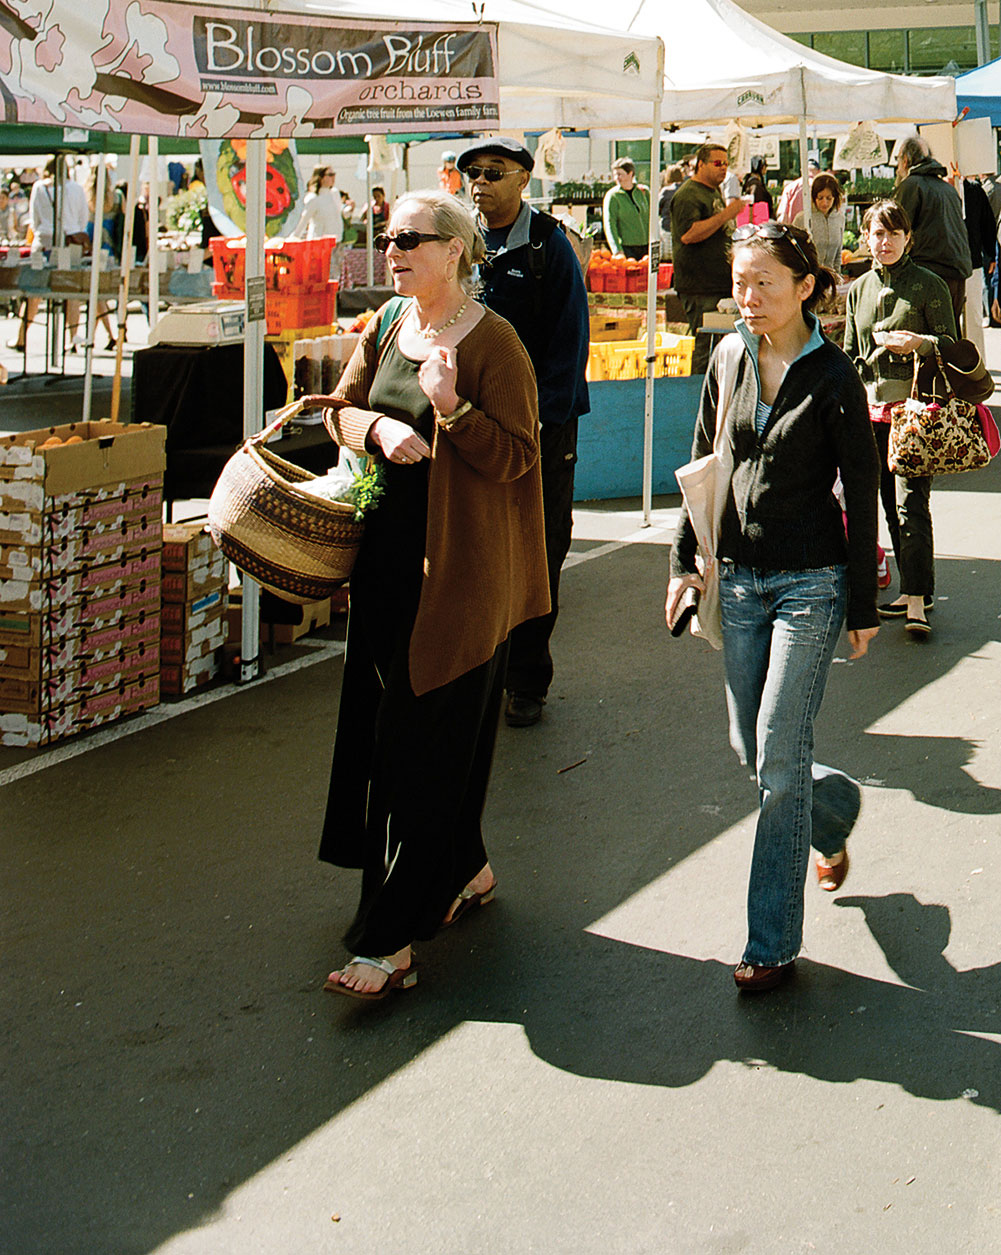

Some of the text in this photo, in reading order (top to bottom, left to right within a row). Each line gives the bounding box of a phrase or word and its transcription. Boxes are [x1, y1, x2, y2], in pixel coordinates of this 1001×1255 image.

[205, 23, 457, 76] Blossom Bluff
[359, 81, 482, 100] orchards
[340, 108, 365, 122] Organic
[366, 108, 379, 119] tree
[380, 107, 395, 119] fruit
[396, 107, 412, 119] from
[414, 108, 425, 118] the
[426, 107, 455, 118] Loewen
[455, 106, 481, 119] family
